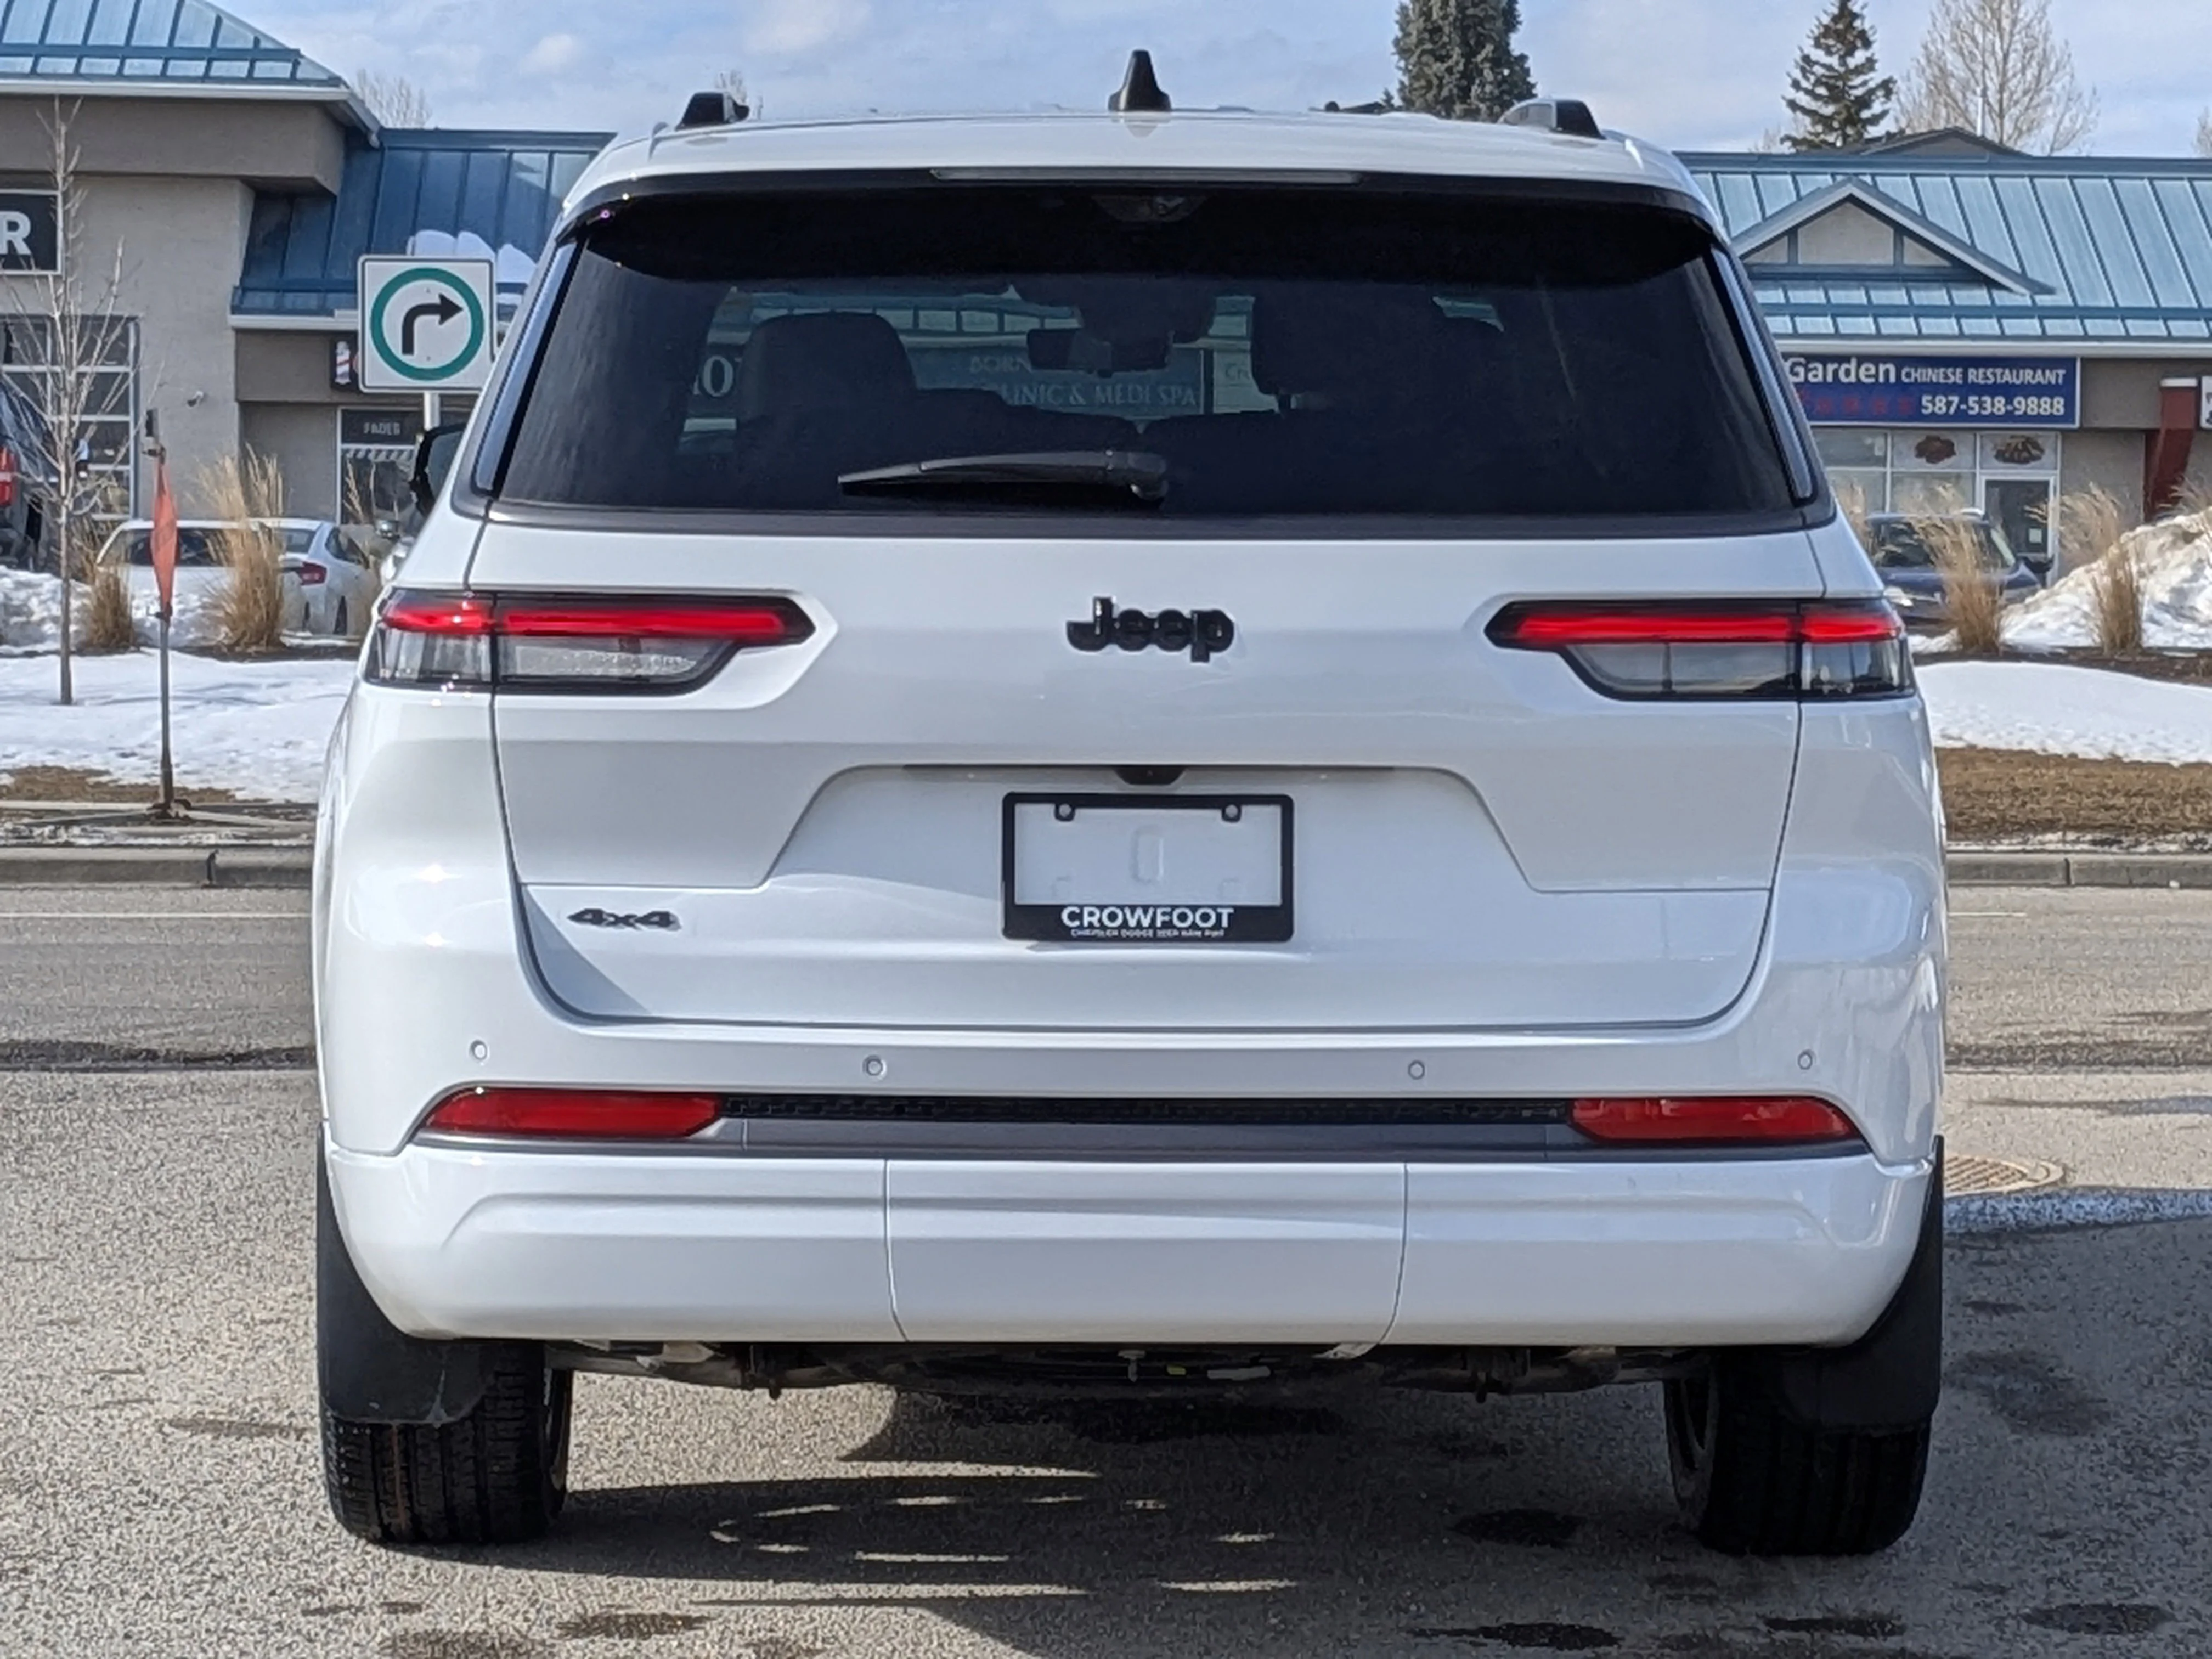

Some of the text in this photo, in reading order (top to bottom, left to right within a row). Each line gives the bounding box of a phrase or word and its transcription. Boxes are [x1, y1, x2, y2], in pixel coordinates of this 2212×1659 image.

[1784, 357, 2066, 385] Garden CHINESE RESTAURANT
[1095, 383, 1152, 405] MEDI
[1159, 384, 1196, 406] SPA
[1921, 395, 2065, 415] 587-538-9888
[1066, 596, 1235, 663] Jeep
[1061, 906, 1234, 928] CROWFOOT
